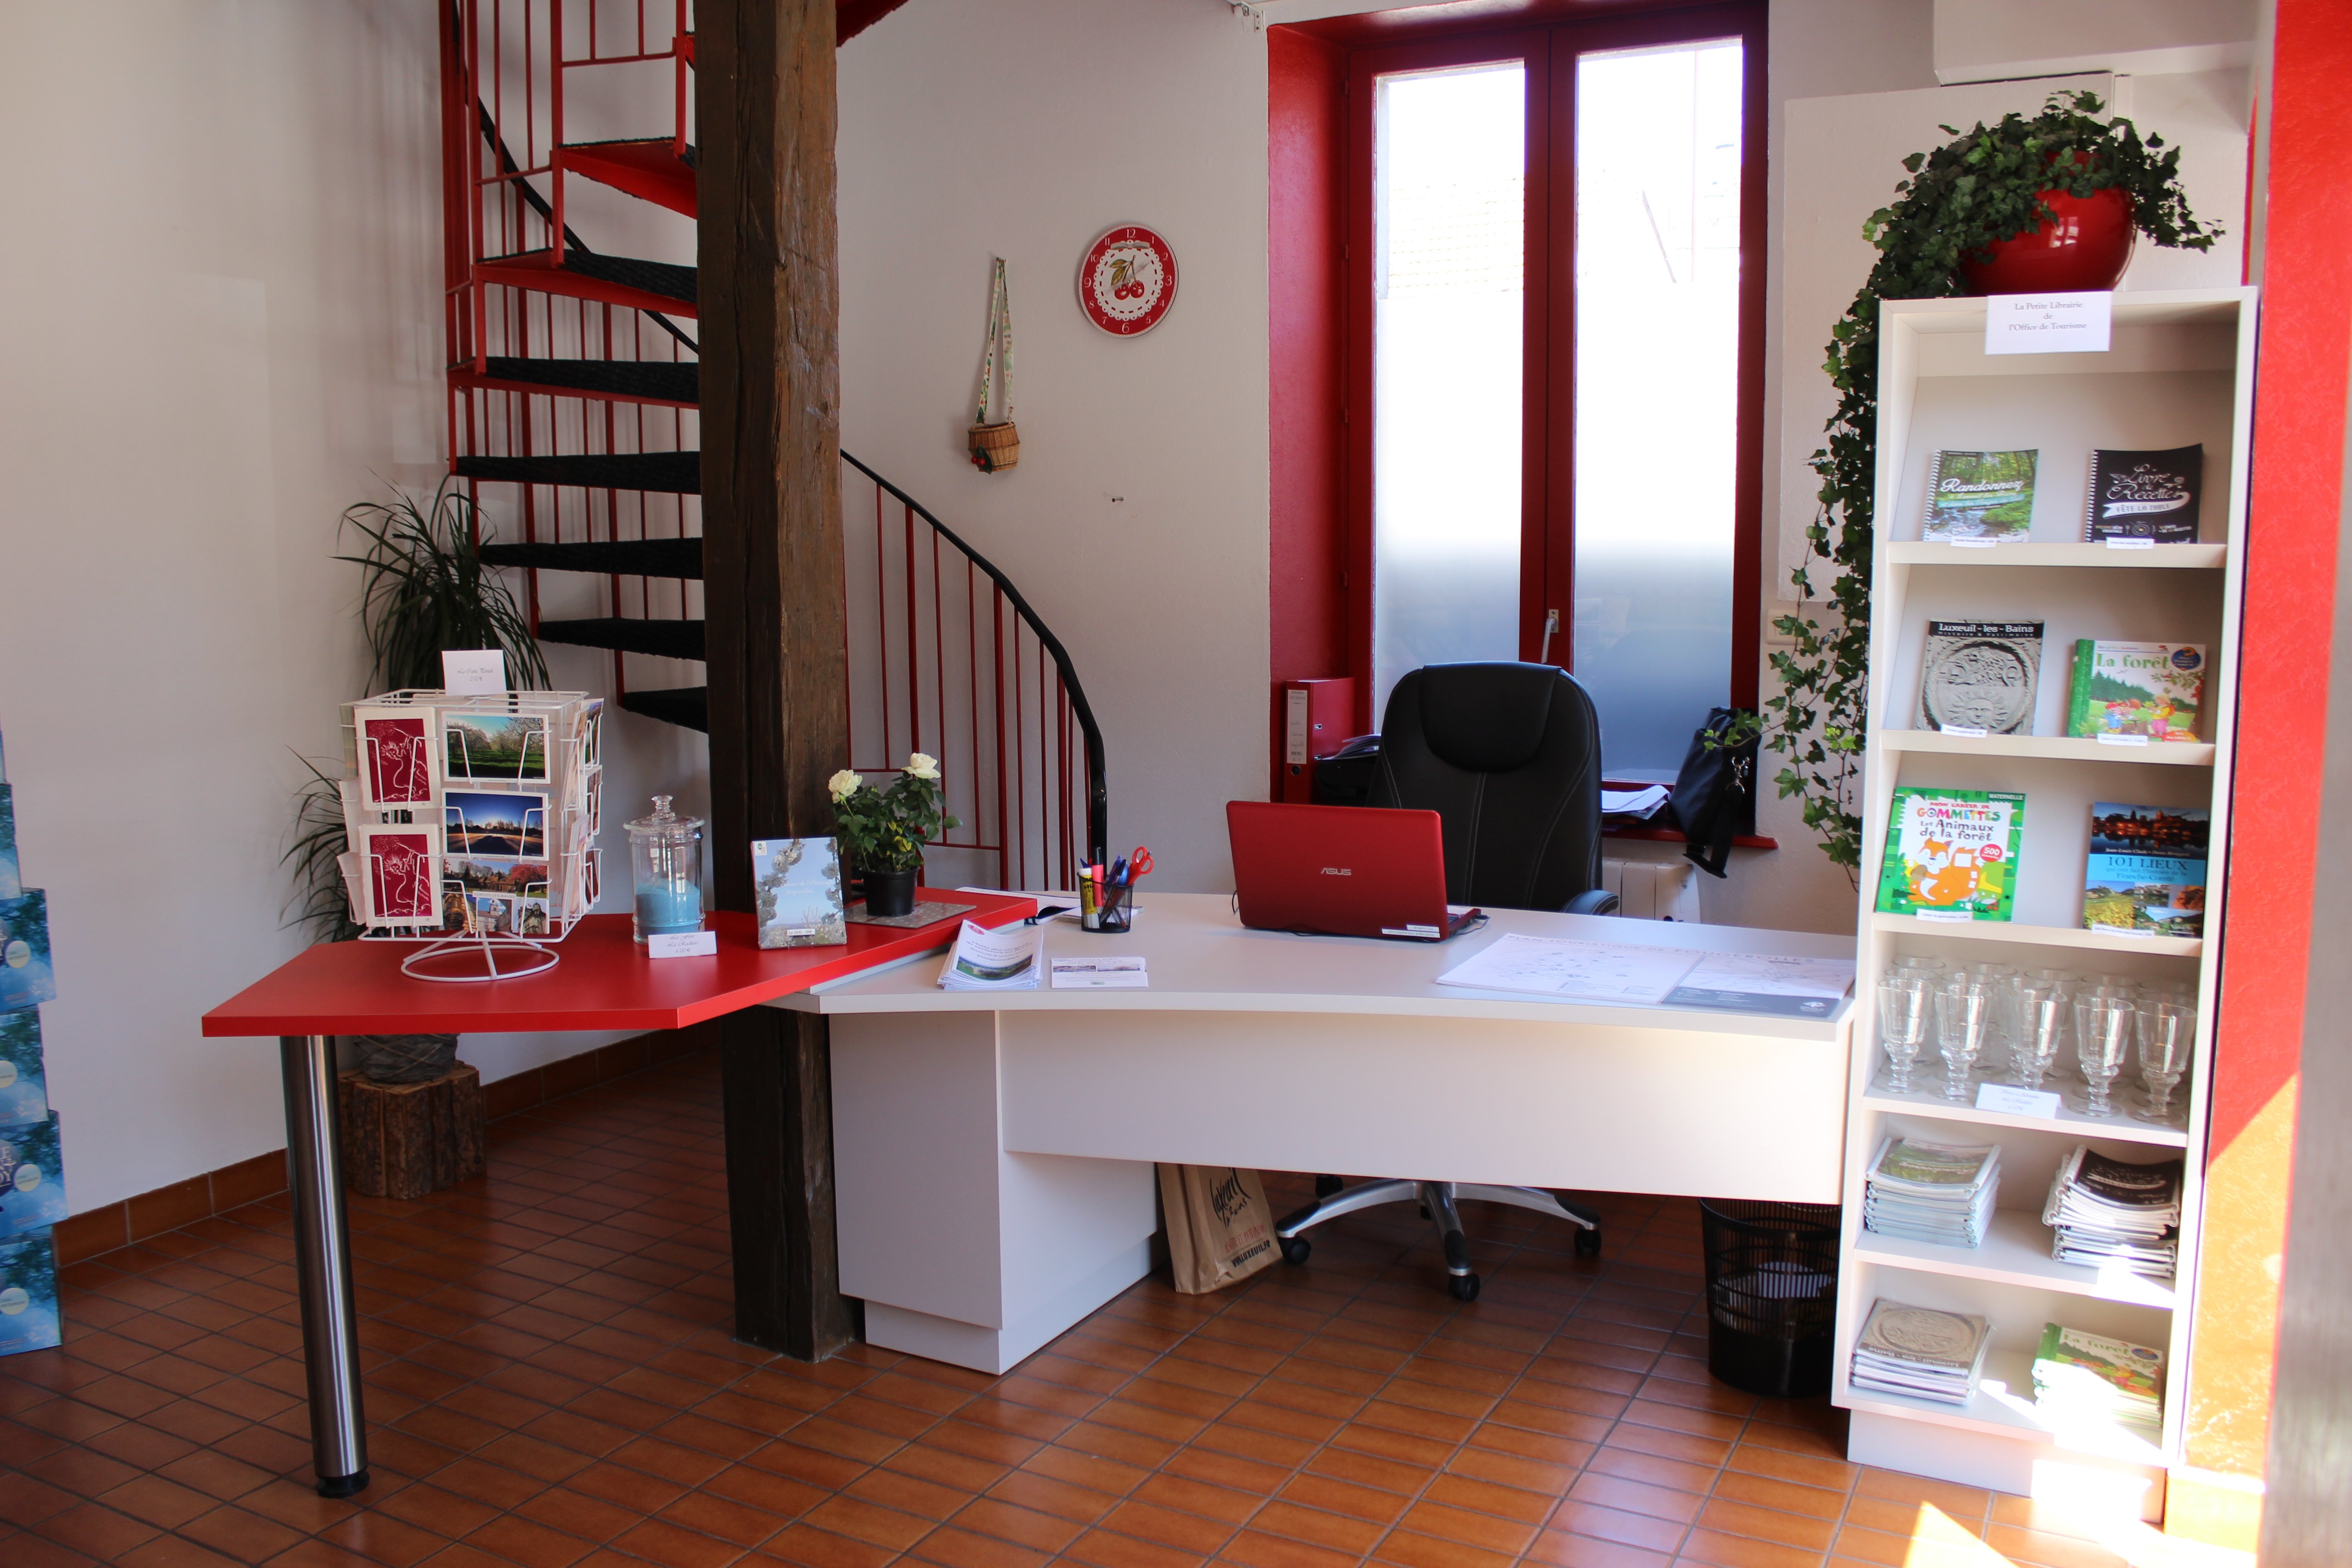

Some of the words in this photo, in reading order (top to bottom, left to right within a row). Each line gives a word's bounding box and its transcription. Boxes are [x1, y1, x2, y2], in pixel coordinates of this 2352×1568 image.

[1127, 229, 1136, 239] 12
[1104, 238, 1110, 246] 11
[1151, 236, 1155, 244] 1
[1090, 254, 1099, 263] 10
[1163, 252, 1168, 261] 2
[1084, 277, 1092, 288] 9
[1165, 275, 1172, 287] 3
[1159, 299, 1165, 308] 4
[2050, 301, 2083, 309] Librairie
[1102, 317, 1107, 325] 7
[1145, 315, 1152, 324] 5
[1122, 323, 1130, 334] 6
[2009, 323, 2038, 331] l'Office
[2051, 322, 2087, 330] Tourisme
[1940, 478, 2025, 493] Randonnez
[2116, 505, 2135, 513] FÊTE
[1939, 623, 1976, 632] Luxeuil
[1983, 624, 1998, 632] les
[2005, 625, 2034, 633] Bains
[2095, 653, 2115, 667] La
[2122, 654, 2170, 670] forêt
[1917, 807, 2001, 822] GOMMETTES
[1935, 819, 1994, 832] Animaux
[1920, 827, 1936, 837] de
[1940, 828, 1953, 838] la
[1957, 829, 1993, 842] forêt
[1984, 847, 2000, 856] 500
[2140, 858, 2188, 871] LIEUX
[1321, 867, 1352, 876] ASUS
[1549, 940, 1641, 950] TOURISTIQUE
[1674, 949, 1815, 963] FOUGEROLLES
